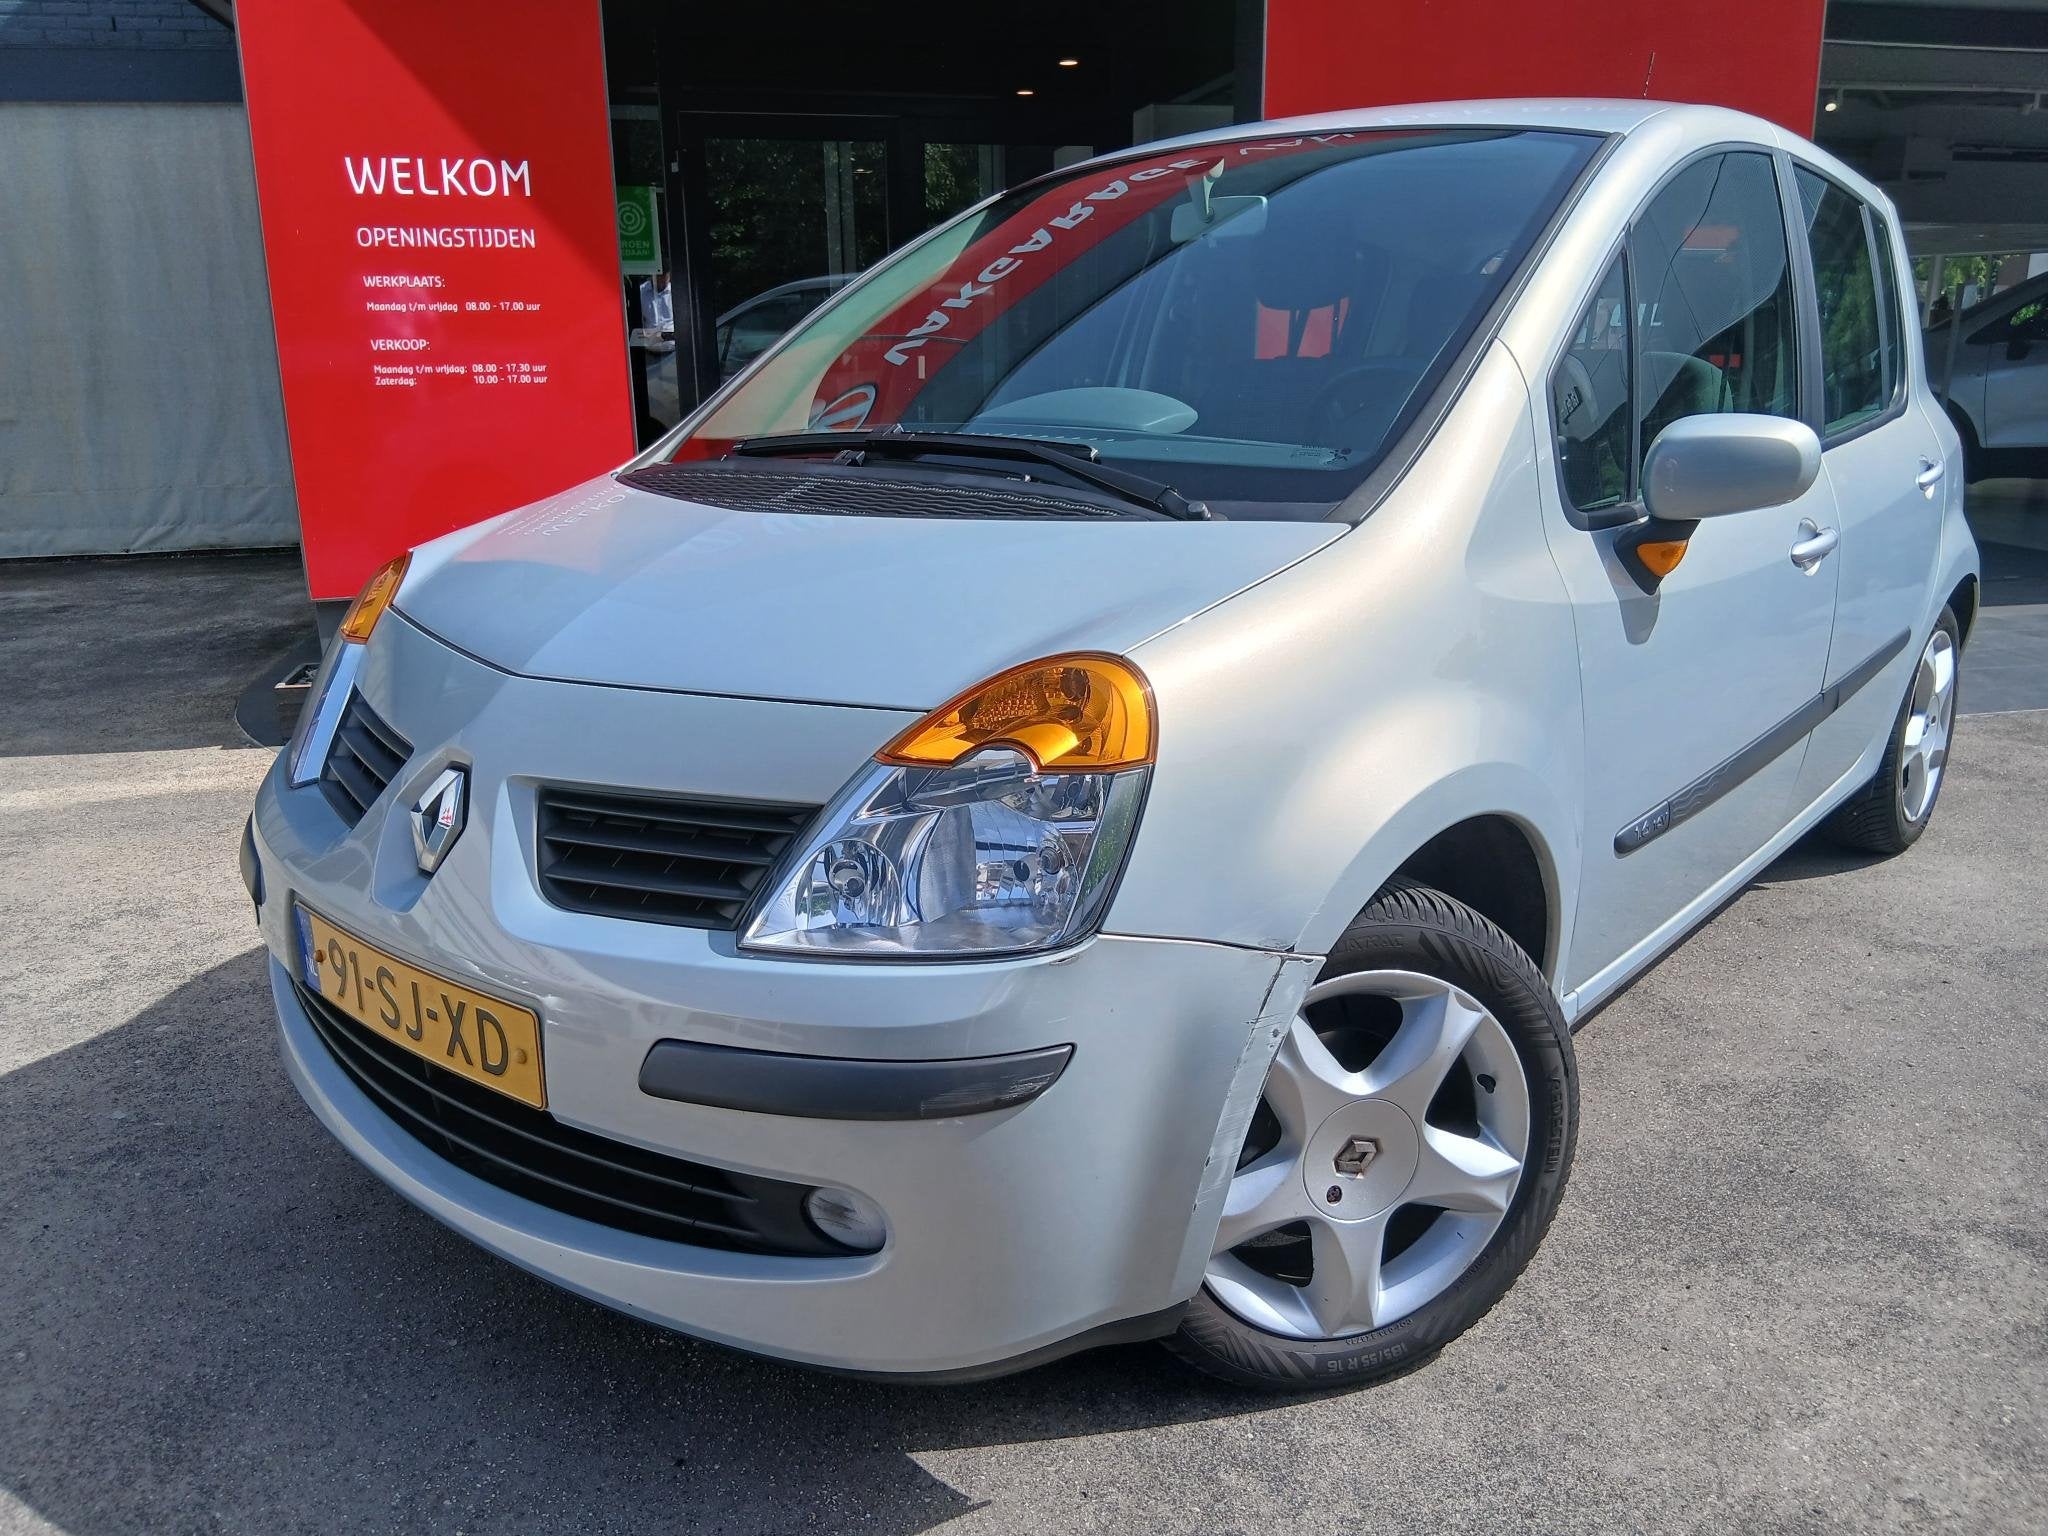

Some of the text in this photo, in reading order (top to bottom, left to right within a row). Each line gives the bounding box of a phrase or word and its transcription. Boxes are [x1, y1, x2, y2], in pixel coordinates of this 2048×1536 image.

[344, 156, 532, 197] WELKOM
[356, 227, 536, 249] OPENINGSTIJDEN
[621, 240, 650, 249] ROEN
[362, 275, 447, 288] WERKPLAATS:
[366, 301, 407, 313] Maandag
[409, 302, 427, 312] t/m
[428, 302, 458, 313] vrijdag
[465, 301, 491, 311] 08.00
[526, 303, 541, 311] uur
[370, 339, 431, 351] VERKOOP:
[373, 364, 414, 375] Maandag
[415, 364, 434, 374] t/m
[435, 364, 468, 375] vrijdag:
[472, 363, 497, 373] 08.00
[505, 363, 530, 372] 17.30
[532, 364, 546, 372] uur
[375, 376, 418, 387] Zaterdag:
[473, 375, 499, 384] 10.00
[506, 374, 531, 384] 17.00
[533, 375, 547, 384] uur
[327, 937, 510, 1076] 91-SJ-XD
